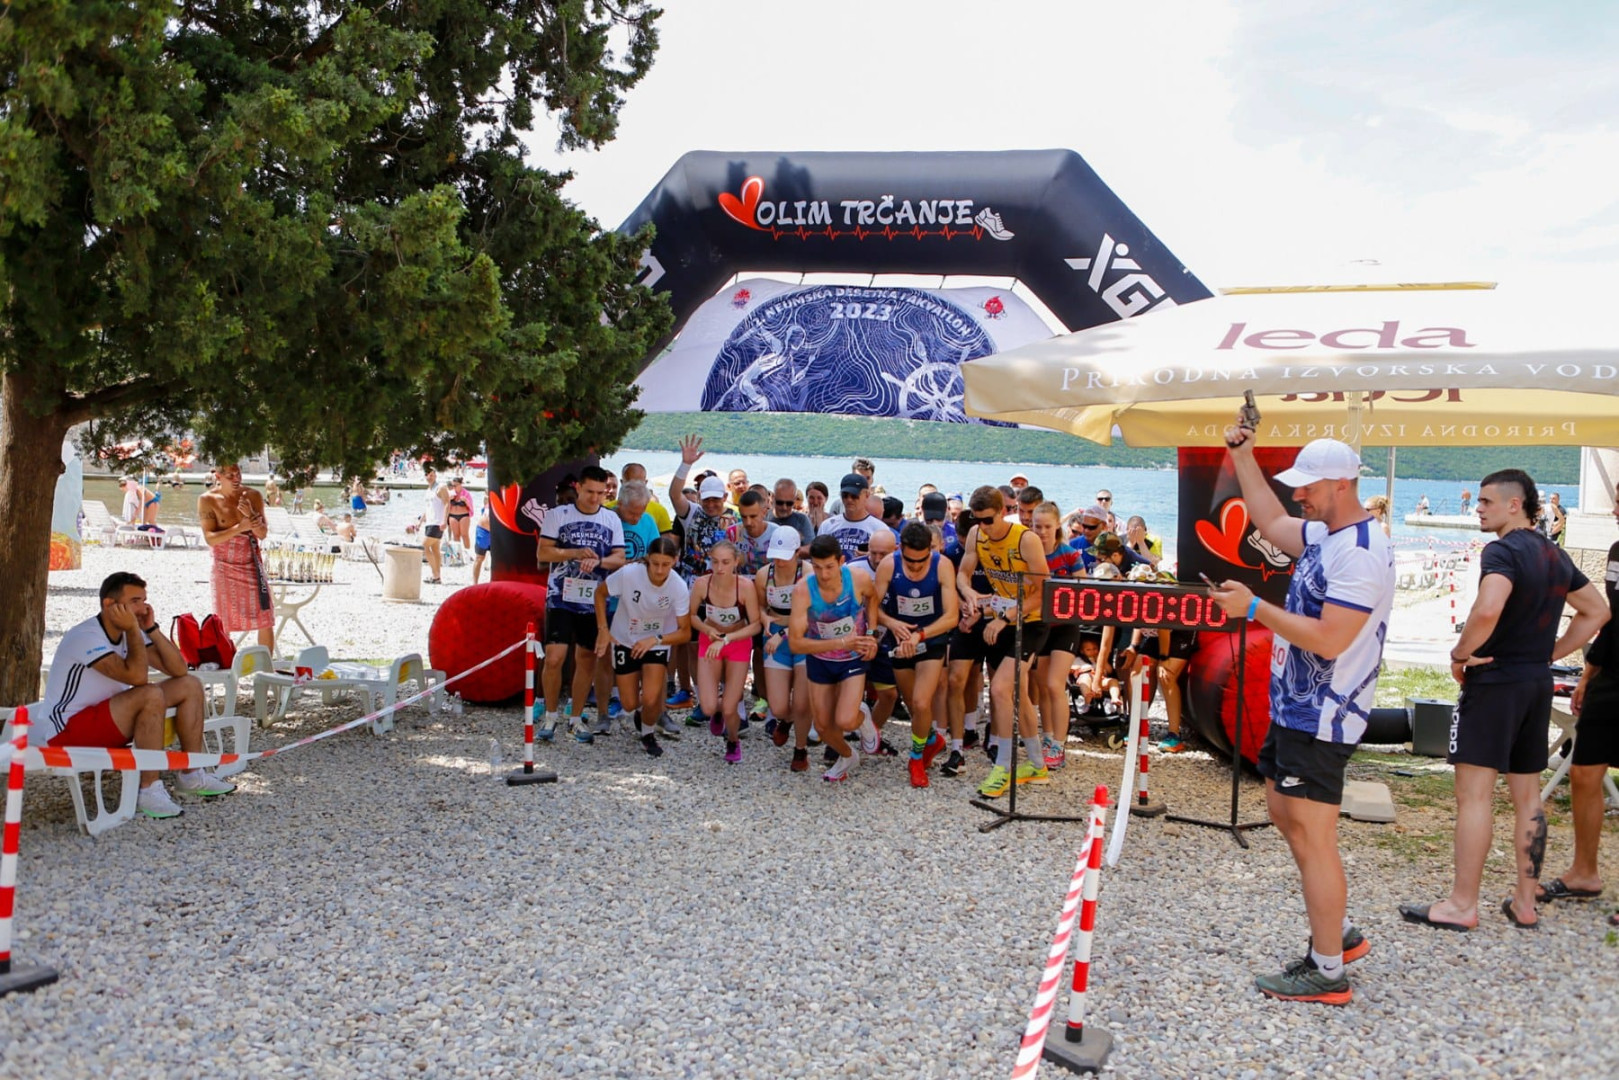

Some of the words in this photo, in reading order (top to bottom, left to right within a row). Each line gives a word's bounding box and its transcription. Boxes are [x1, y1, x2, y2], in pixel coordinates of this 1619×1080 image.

[840, 195, 975, 225] TRČANJE
[767, 290, 833, 316] NEUMSKA
[836, 288, 898, 299] DESETKA
[909, 294, 973, 337] AKVATLON
[830, 302, 893, 321] 2023
[1214, 320, 1478, 350] leda
[1281, 363, 1501, 379] IZVORSKA
[578, 587, 593, 598] 15
[632, 590, 641, 603] 3
[913, 602, 930, 612] 25
[1053, 587, 1227, 627] 00:00:00
[719, 613, 736, 623] 29
[643, 622, 660, 632] 35
[834, 623, 851, 636] 26
[617, 650, 625, 665] 3
